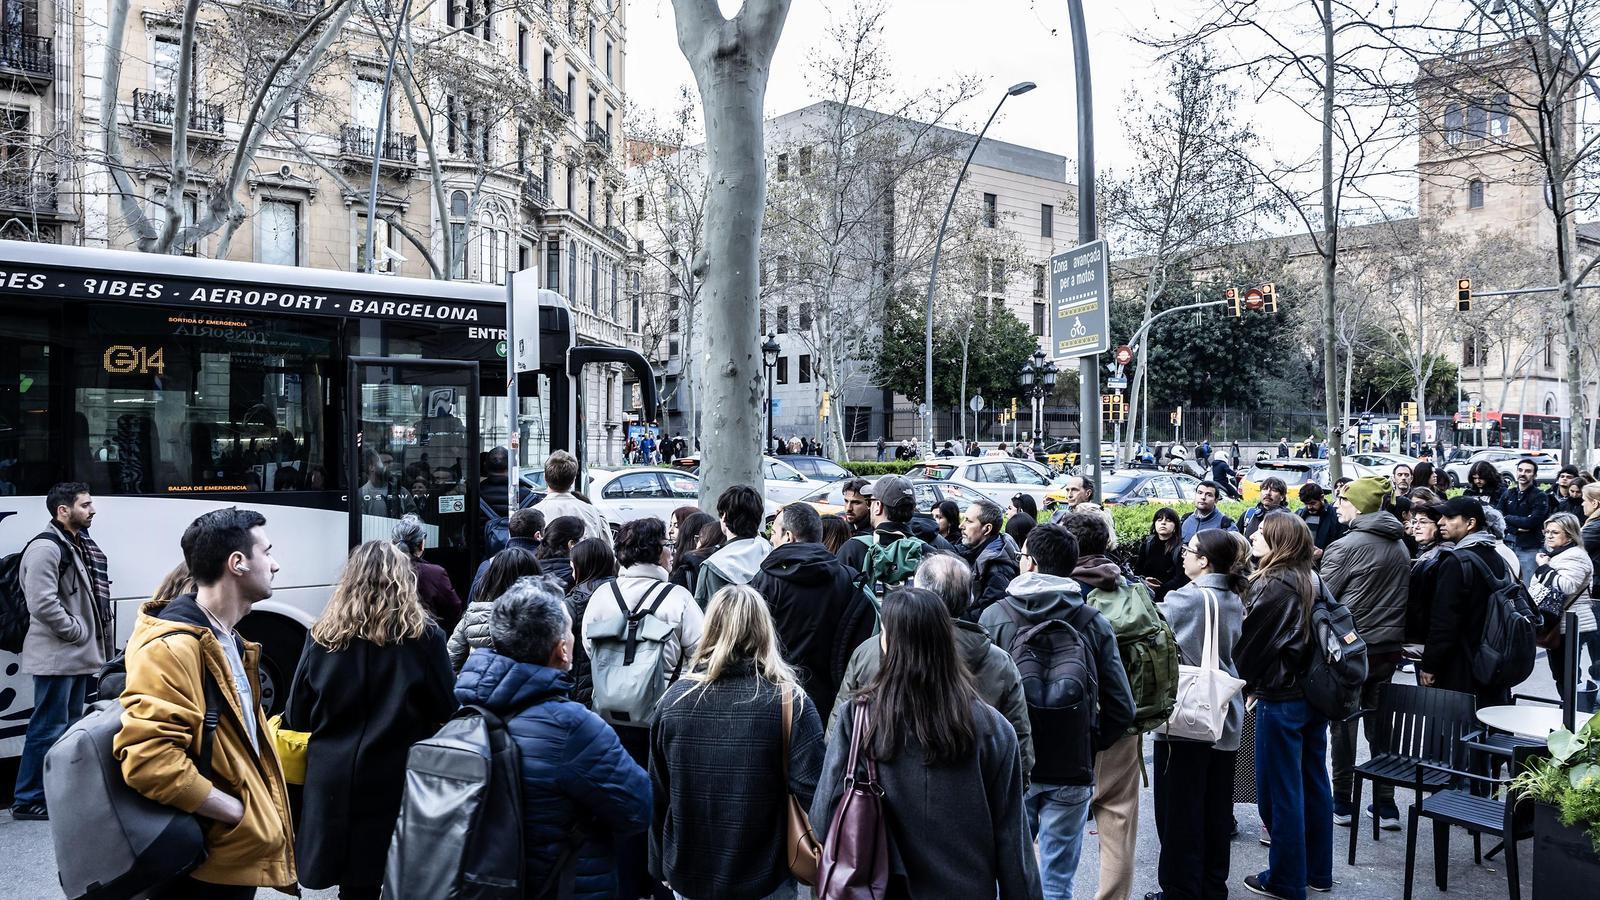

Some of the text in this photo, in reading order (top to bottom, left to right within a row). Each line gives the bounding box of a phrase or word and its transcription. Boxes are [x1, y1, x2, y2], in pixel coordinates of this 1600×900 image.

[1053, 259, 1068, 274] Zona
[1060, 269, 1095, 293] per a motos
[83, 278, 164, 299] RIBES
[190, 287, 327, 309] AEROPORT
[349, 299, 478, 322] BARCELONA
[468, 327, 508, 340] ENTR
